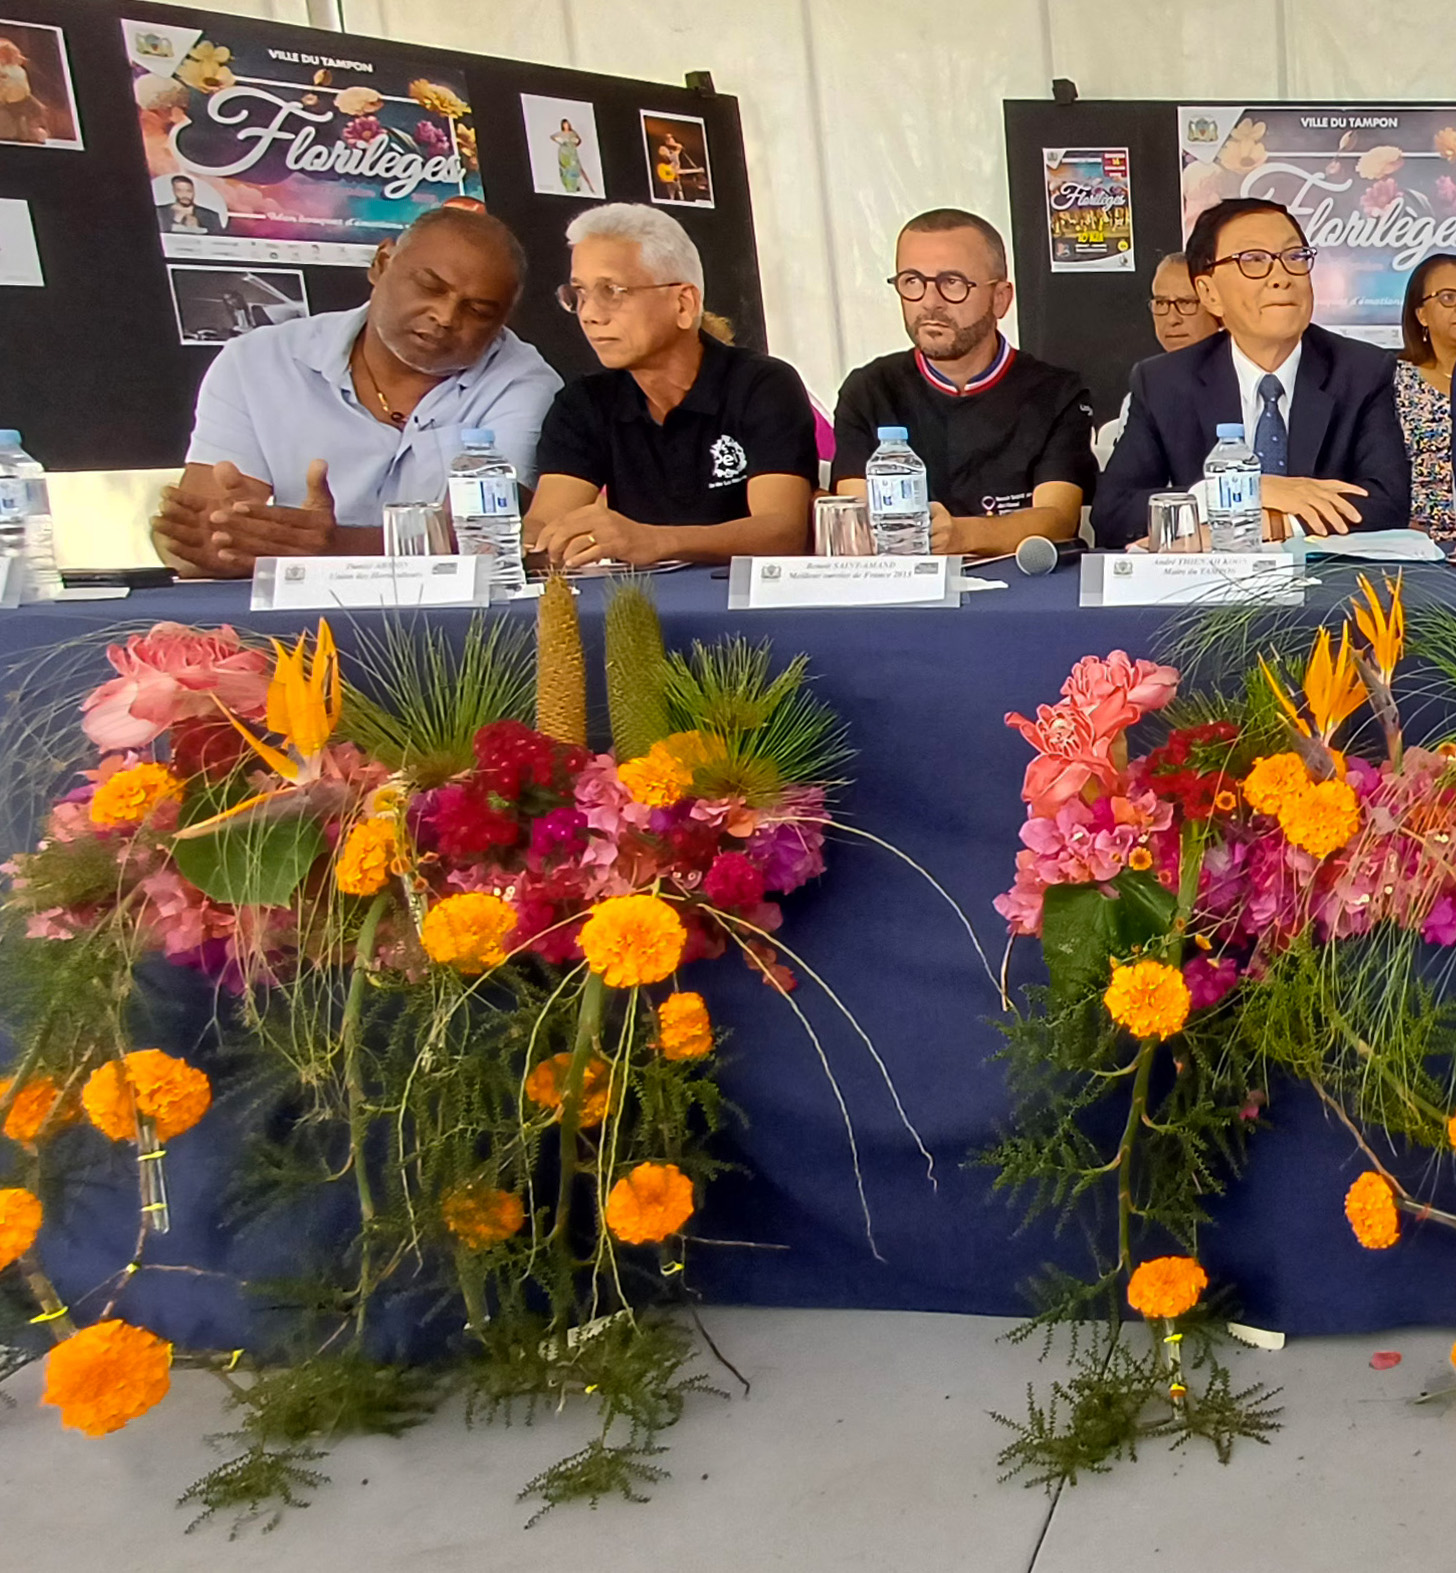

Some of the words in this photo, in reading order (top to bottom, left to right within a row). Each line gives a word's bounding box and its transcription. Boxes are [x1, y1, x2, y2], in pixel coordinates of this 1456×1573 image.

[267, 49, 299, 62] VILLE
[301, 54, 319, 65] DU
[320, 57, 373, 73] TAMPON
[1301, 117, 1328, 128] VILLE
[1330, 117, 1347, 128] DU
[1348, 117, 1398, 128] TAMPON
[168, 86, 466, 200] Florilèges
